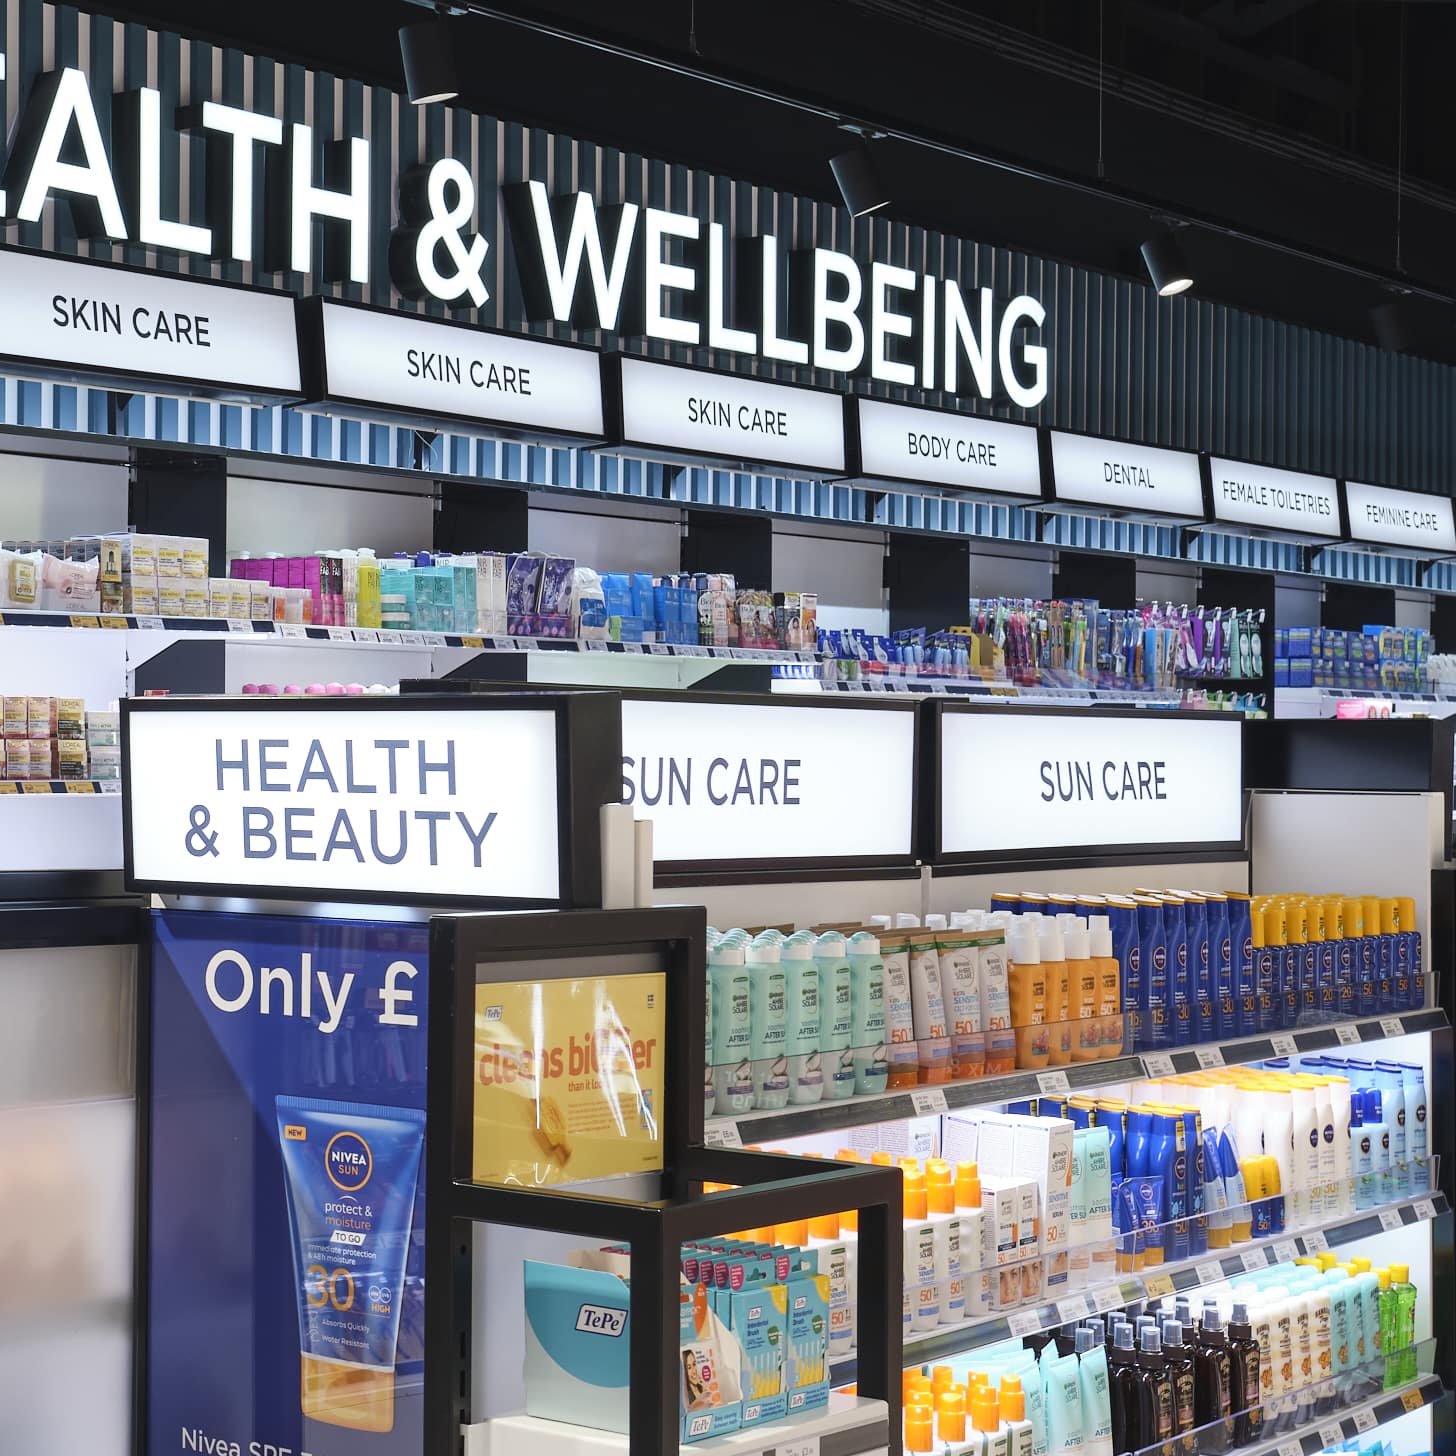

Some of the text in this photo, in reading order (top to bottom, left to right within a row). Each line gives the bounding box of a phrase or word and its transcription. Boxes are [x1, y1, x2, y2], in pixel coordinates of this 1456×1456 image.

[415, 157, 490, 304] &
[528, 176, 1049, 409] WELLBEING
[52, 294, 211, 348] SKIN CARE
[407, 349, 532, 396] SKIN CARE
[688, 397, 788, 437] SKIN CARE
[907, 432, 997, 467] BODY CARE
[1103, 462, 1155, 489] DENTAL
[1222, 480, 1331, 516] FEMALE TOILETRIES
[1366, 504, 1439, 531] FEMININE CARE
[215, 738, 457, 796] HEALTH
[706, 757, 802, 806] CARE
[1040, 760, 1167, 802] SUN CARE
[184, 804, 499, 868] & BEAUTY
[205, 949, 419, 1034] Only £
[331, 1151, 367, 1166] NIVEA
[338, 1164, 359, 1176] SUN
[324, 1202, 373, 1217] protect &
[325, 1215, 372, 1231] moisture
[335, 1232, 361, 1244] TO GO
[342, 1247, 377, 1259] protection
[305, 1264, 355, 1312] 30
[371, 1303, 391, 1313] HIGH
[583, 1309, 621, 1331] TePe
